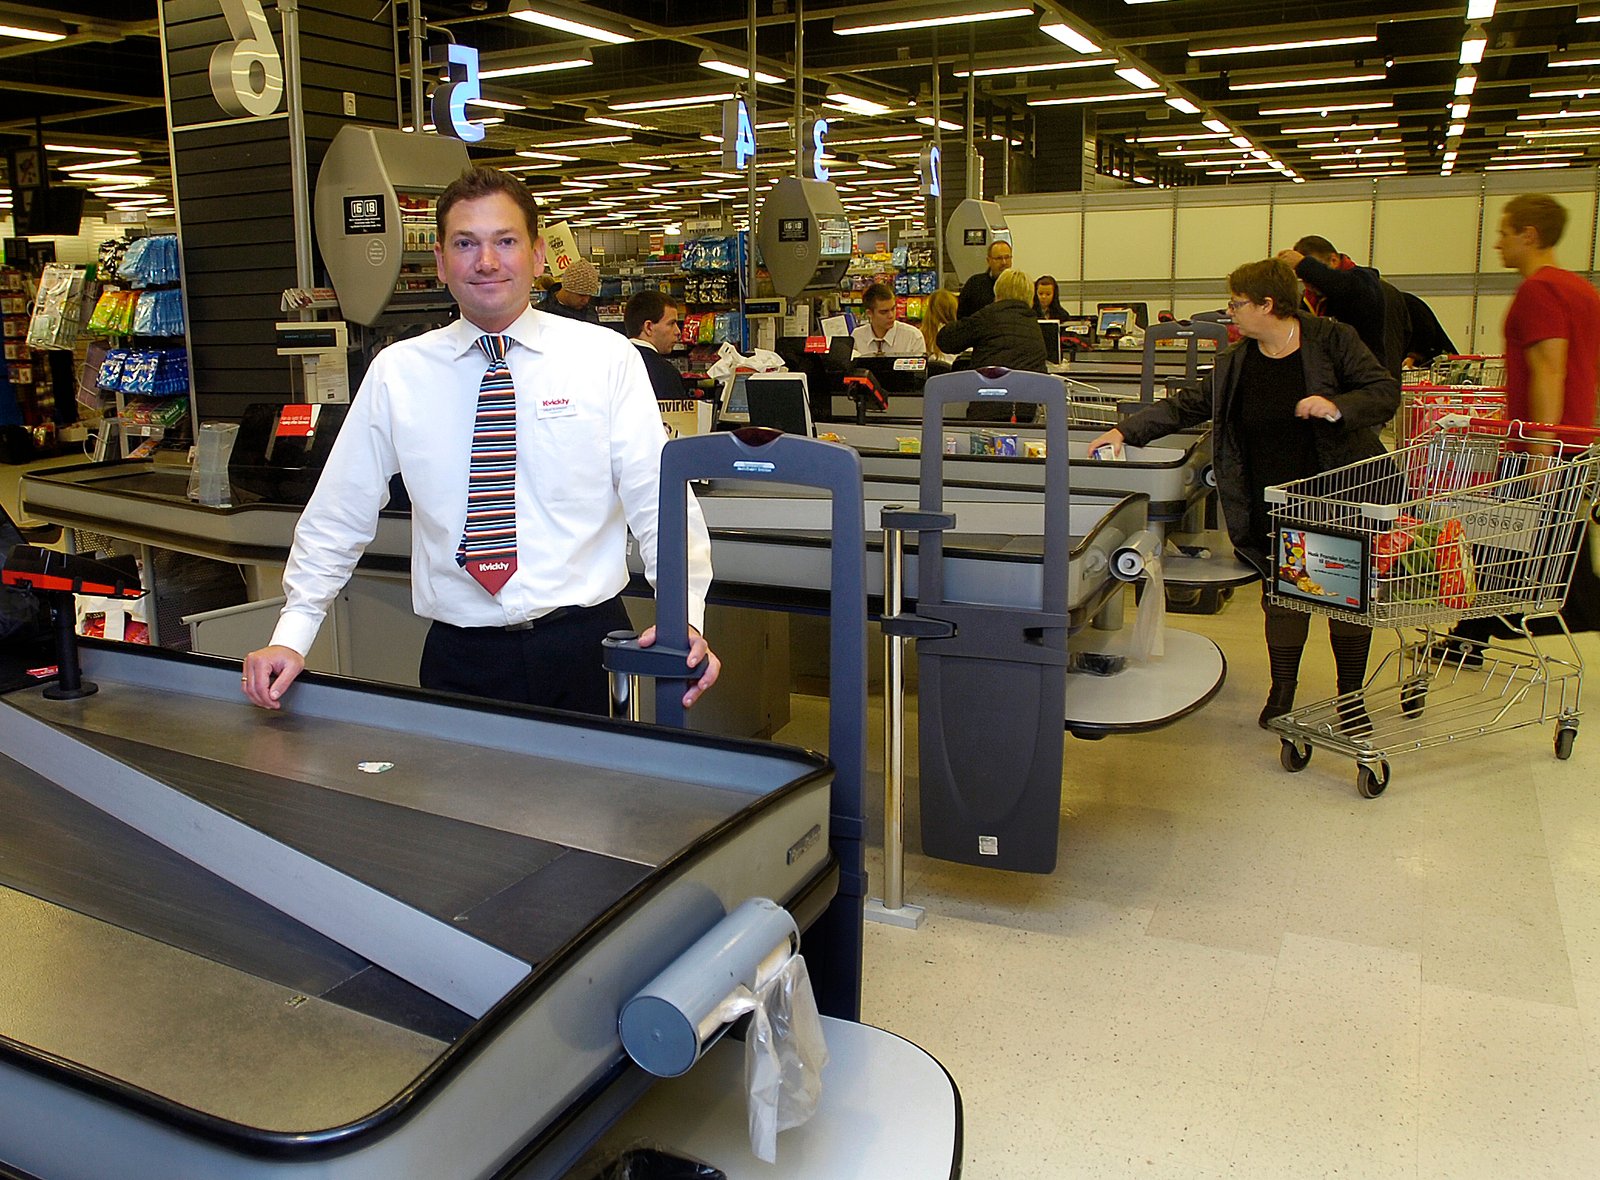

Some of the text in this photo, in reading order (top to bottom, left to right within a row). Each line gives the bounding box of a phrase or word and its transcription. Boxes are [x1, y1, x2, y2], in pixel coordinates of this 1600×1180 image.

[215, 0, 283, 116] 6
[443, 43, 486, 142] 5
[731, 100, 756, 170] 4
[810, 119, 830, 182] 3
[926, 146, 940, 196] 2
[353, 202, 376, 213] 16 18
[542, 398, 570, 406] Kvickly
[478, 561, 510, 572] Kvickly
